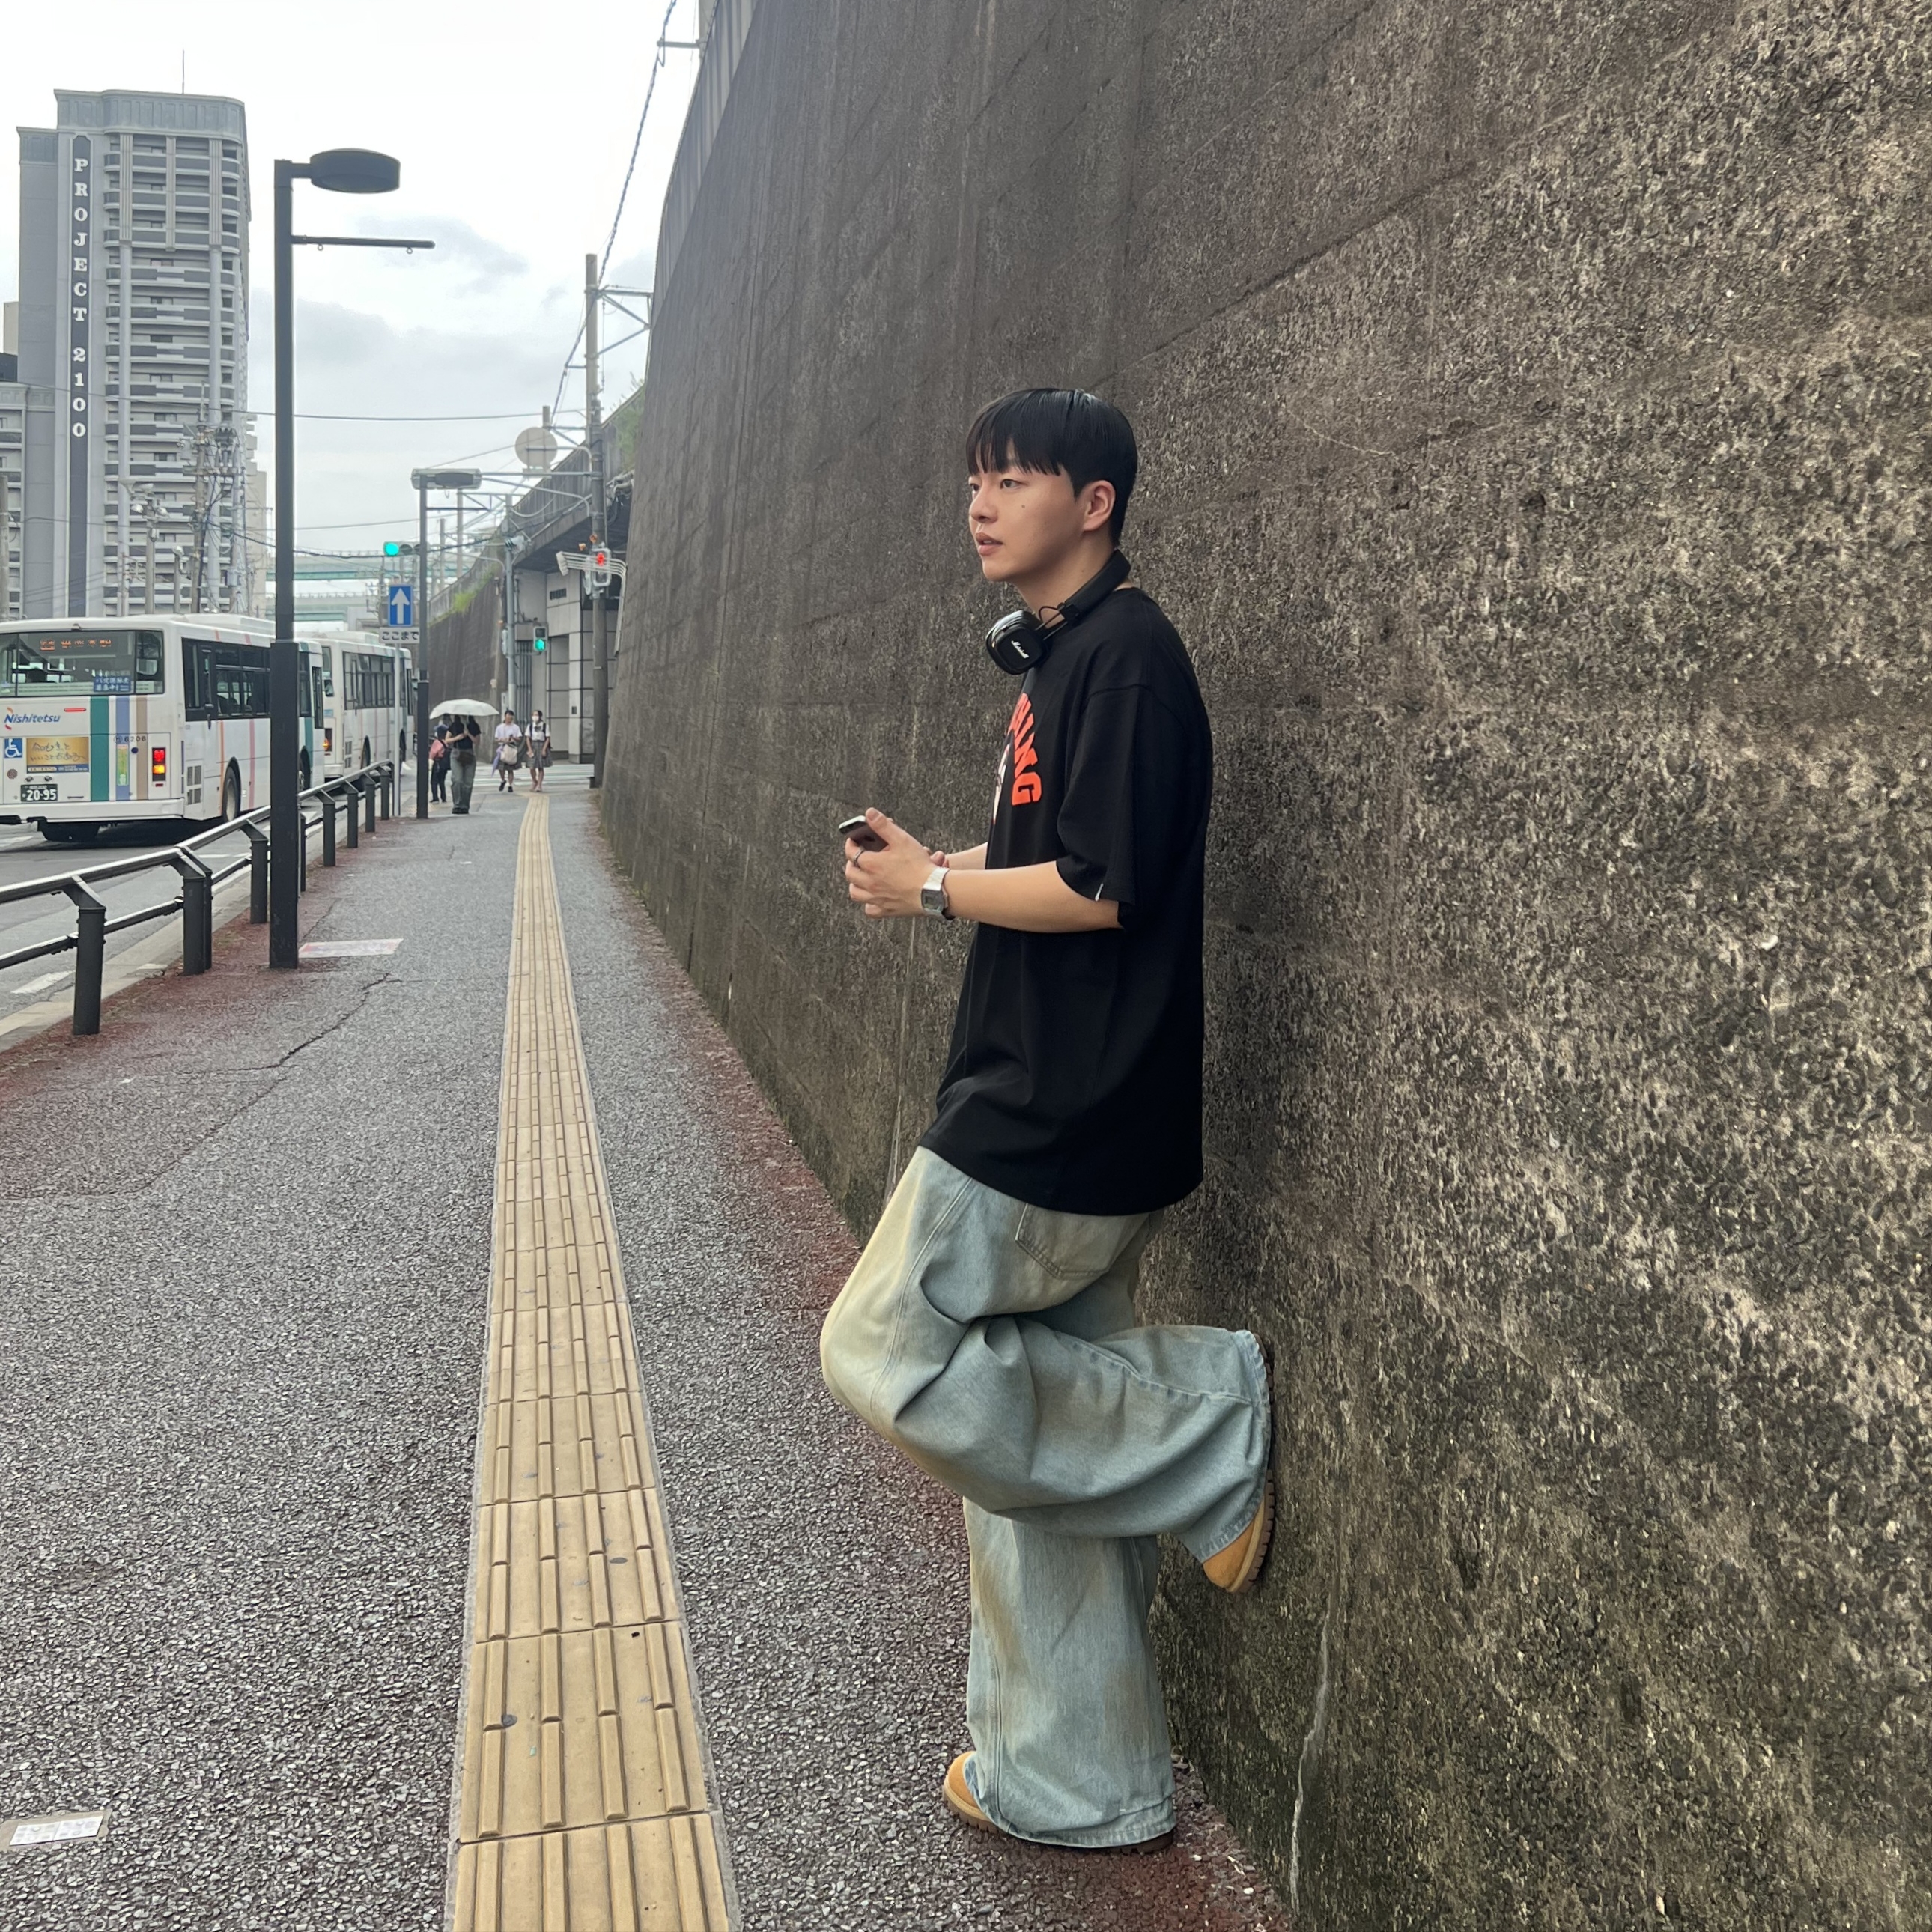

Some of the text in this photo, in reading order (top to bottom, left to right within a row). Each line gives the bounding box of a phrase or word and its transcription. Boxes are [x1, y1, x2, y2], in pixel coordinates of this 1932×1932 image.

[73, 158, 88, 437] PROJECT 2100
[382, 631, 419, 640] ここまで
[4, 714, 61, 723] Nishitetsu
